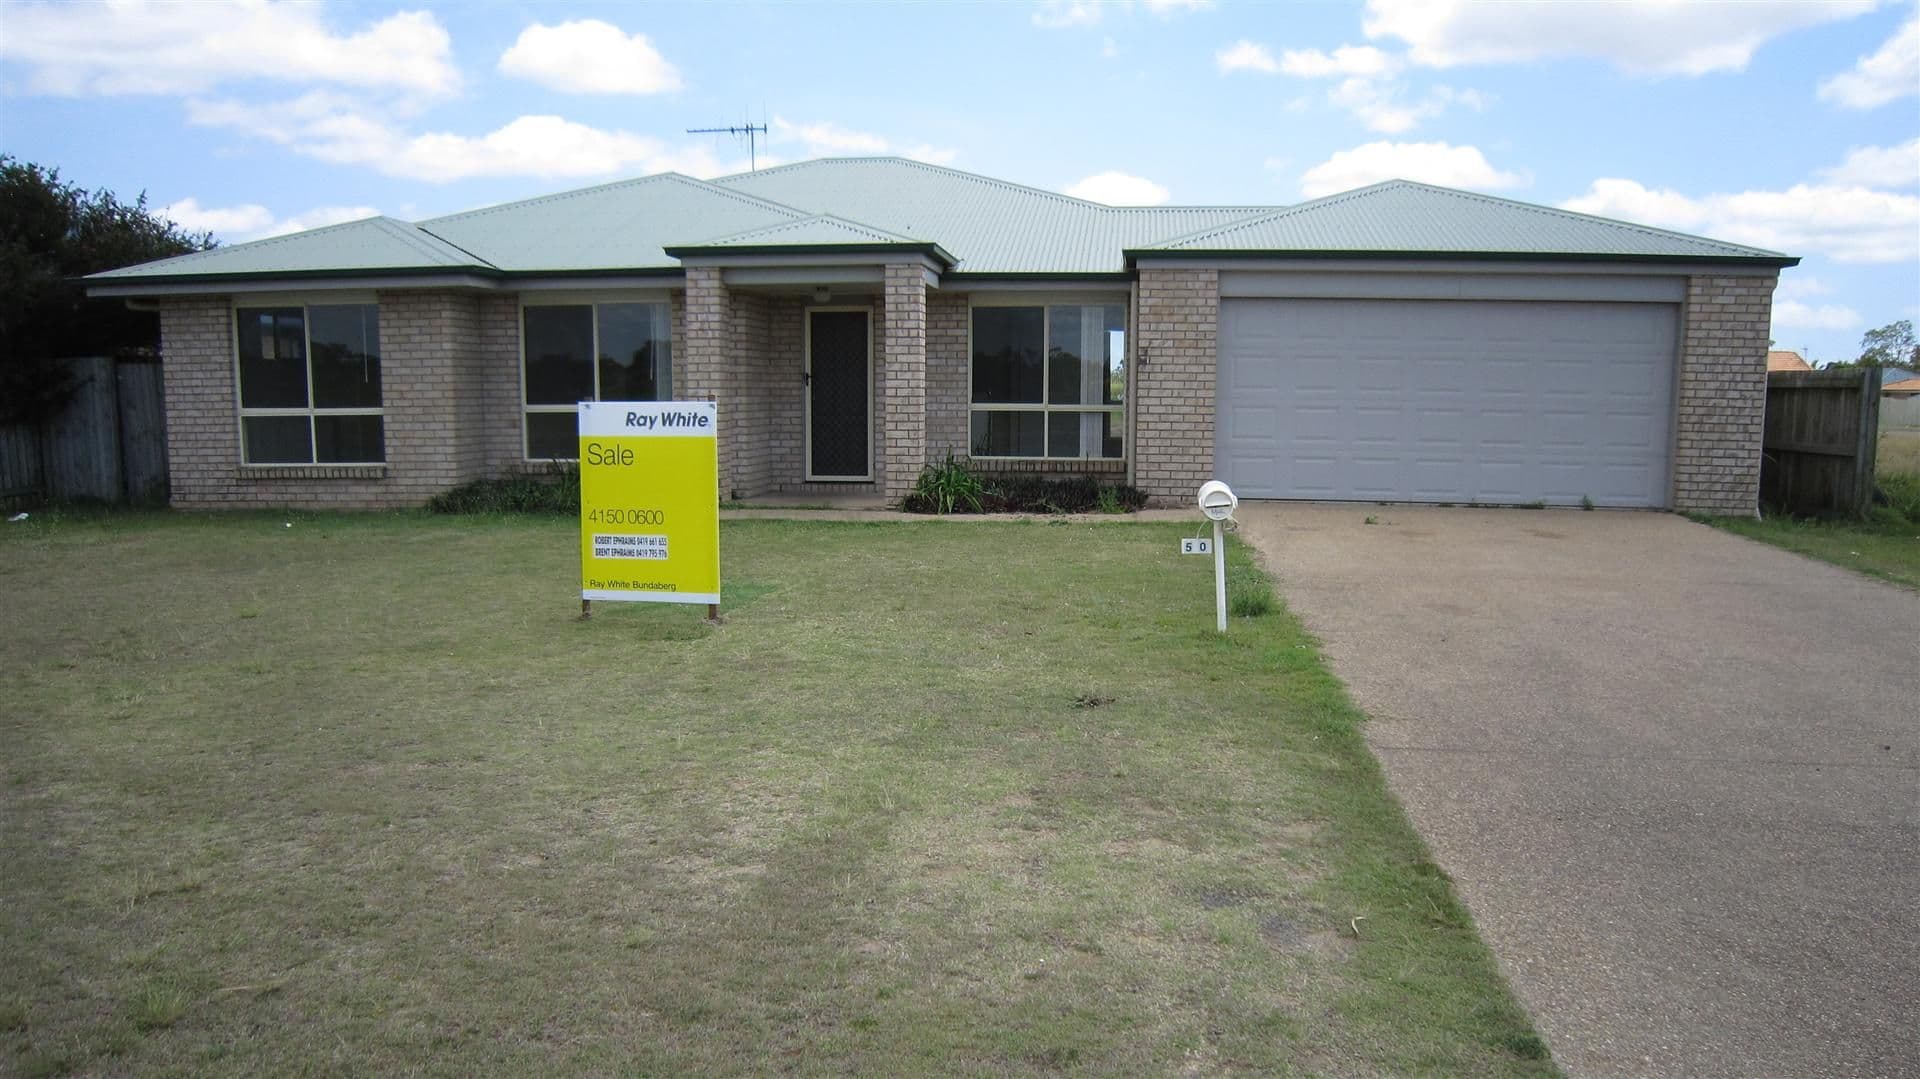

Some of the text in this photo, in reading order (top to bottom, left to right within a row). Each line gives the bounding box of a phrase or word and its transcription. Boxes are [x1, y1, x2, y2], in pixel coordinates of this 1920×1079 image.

[625, 411, 709, 430] Ray White
[587, 442, 634, 466] Sale
[588, 508, 664, 525] 4150 0600
[595, 536, 612, 545] ROBERT
[637, 537, 648, 546] 0419
[1185, 542, 1207, 552] 50
[595, 548, 611, 556] BRENT
[636, 549, 648, 557] 0419
[590, 579, 677, 592] Ray White Bundaberg
